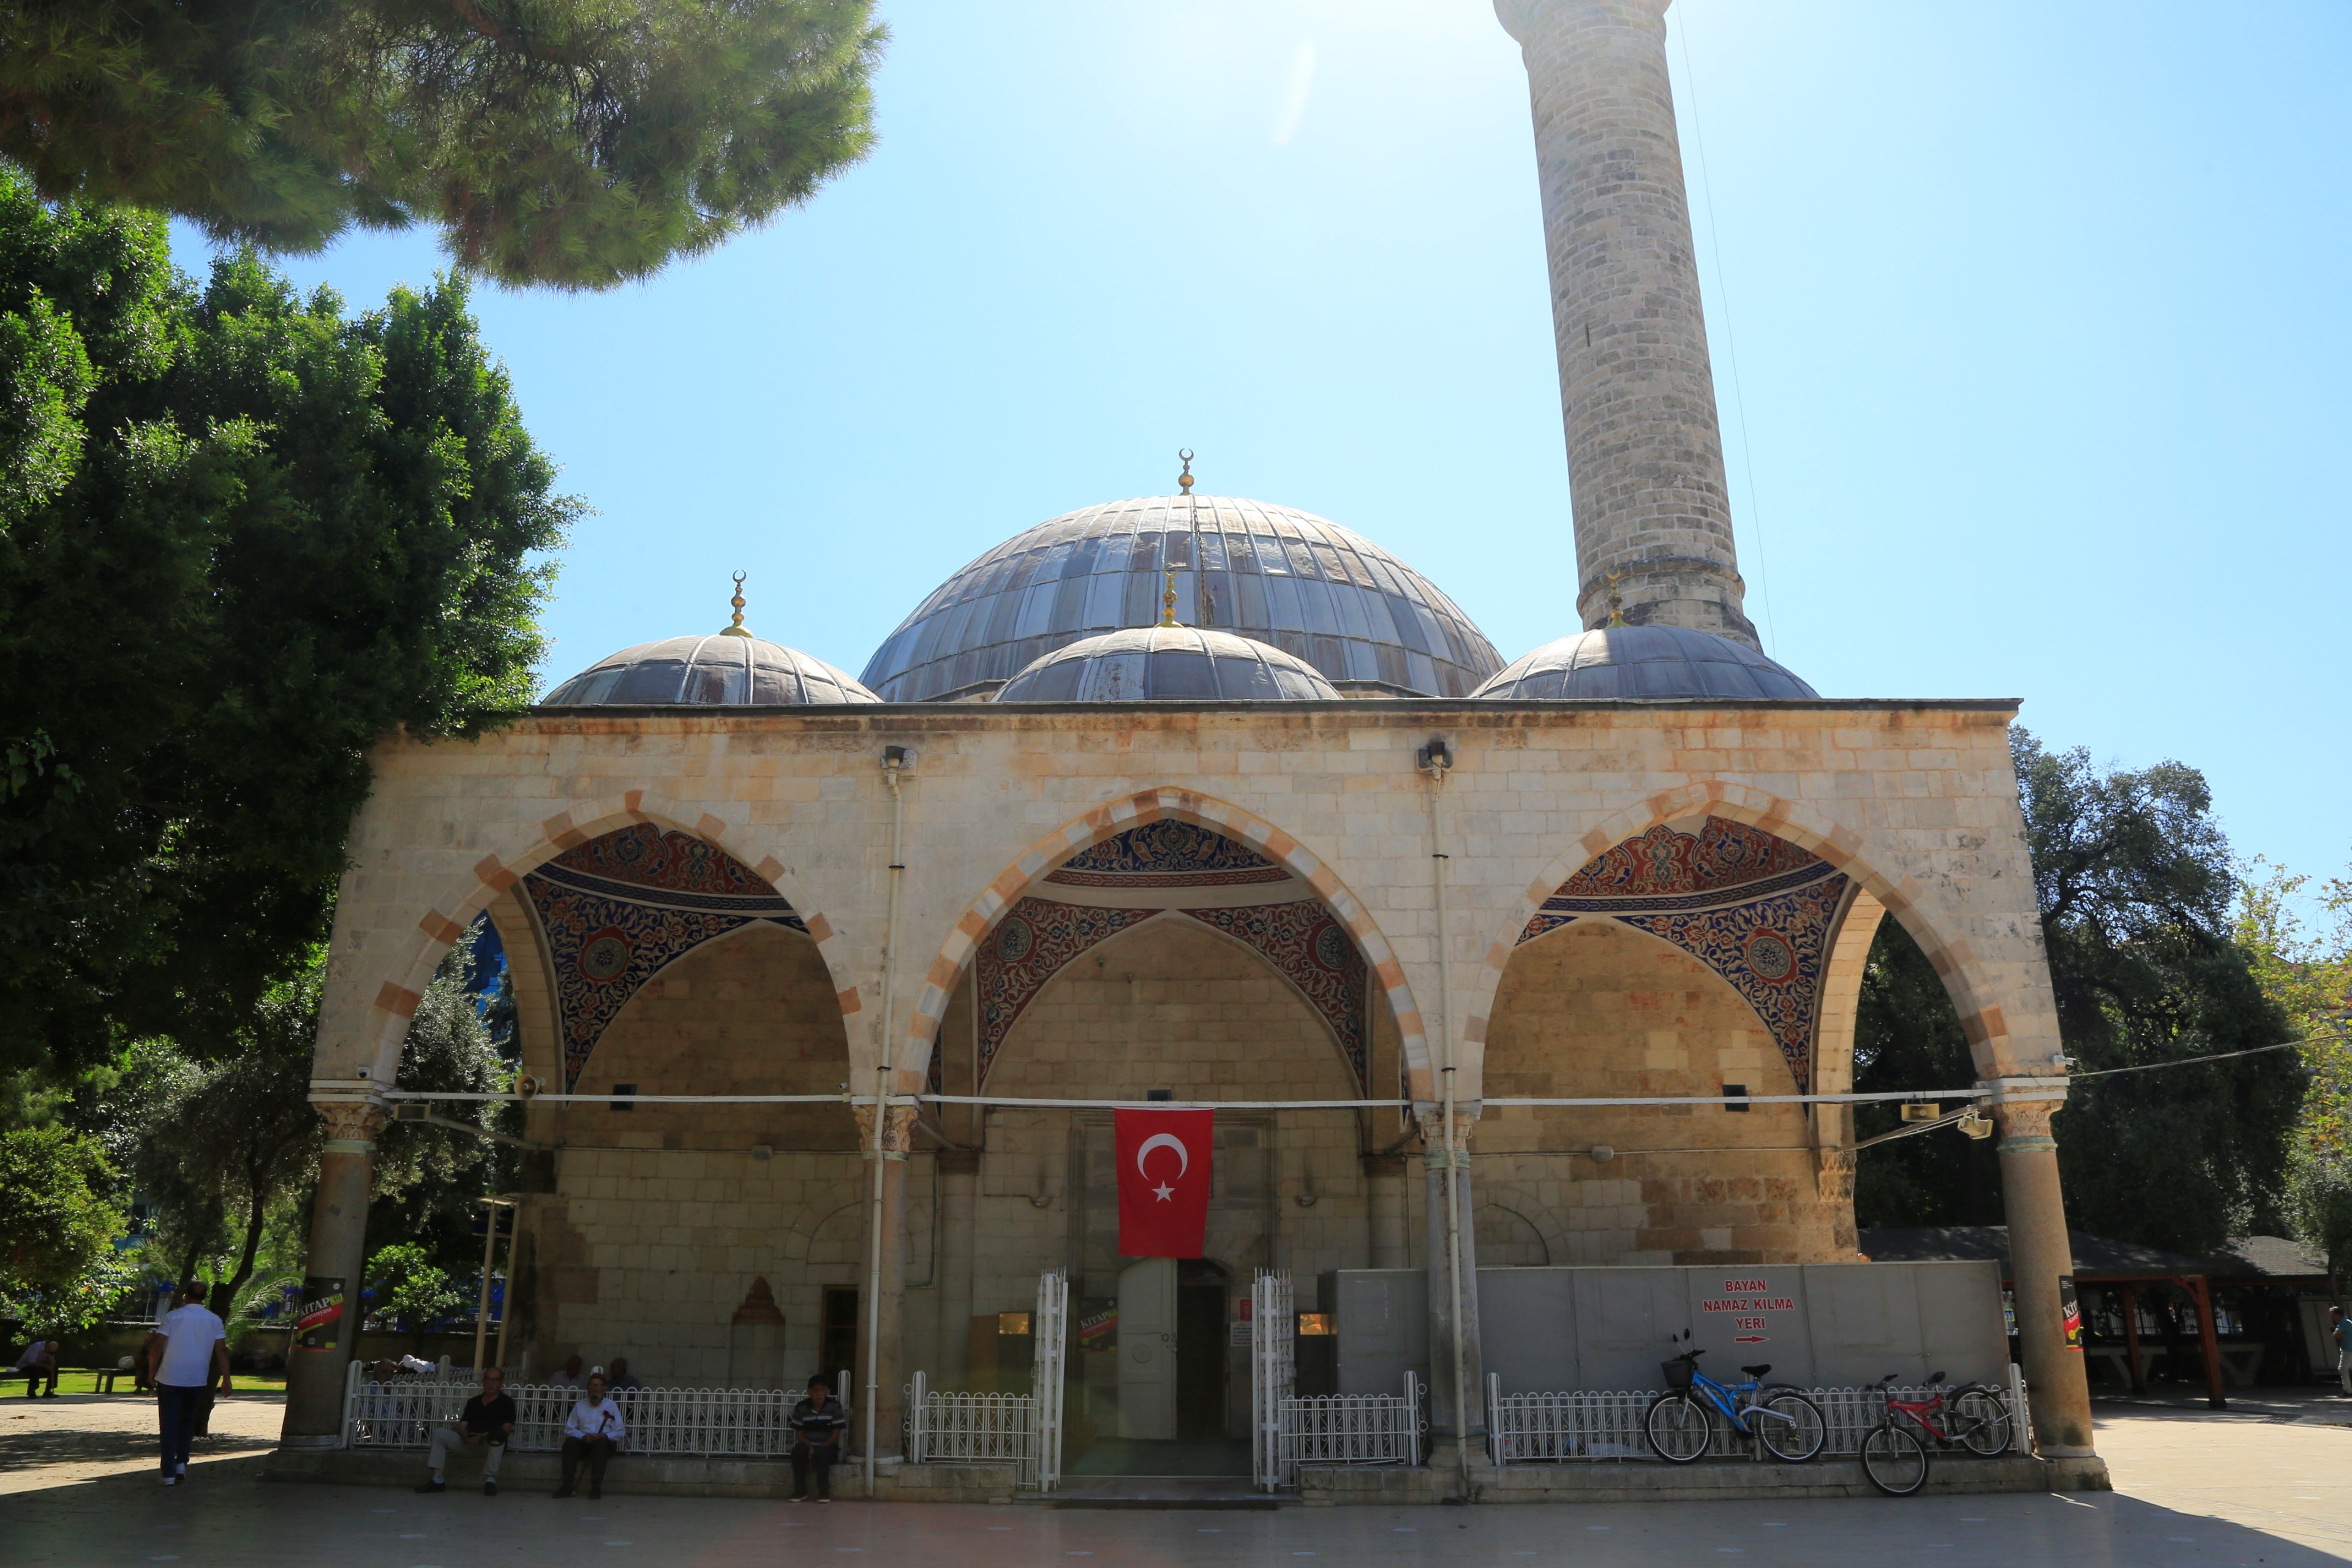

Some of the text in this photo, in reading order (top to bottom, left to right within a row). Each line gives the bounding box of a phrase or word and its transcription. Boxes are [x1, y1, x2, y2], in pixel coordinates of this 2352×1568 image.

[1725, 1280, 1767, 1292] BAYAN
[1703, 1297, 1795, 1312] NAMAZ KILMA
[1735, 1314, 1766, 1330] YERİ
